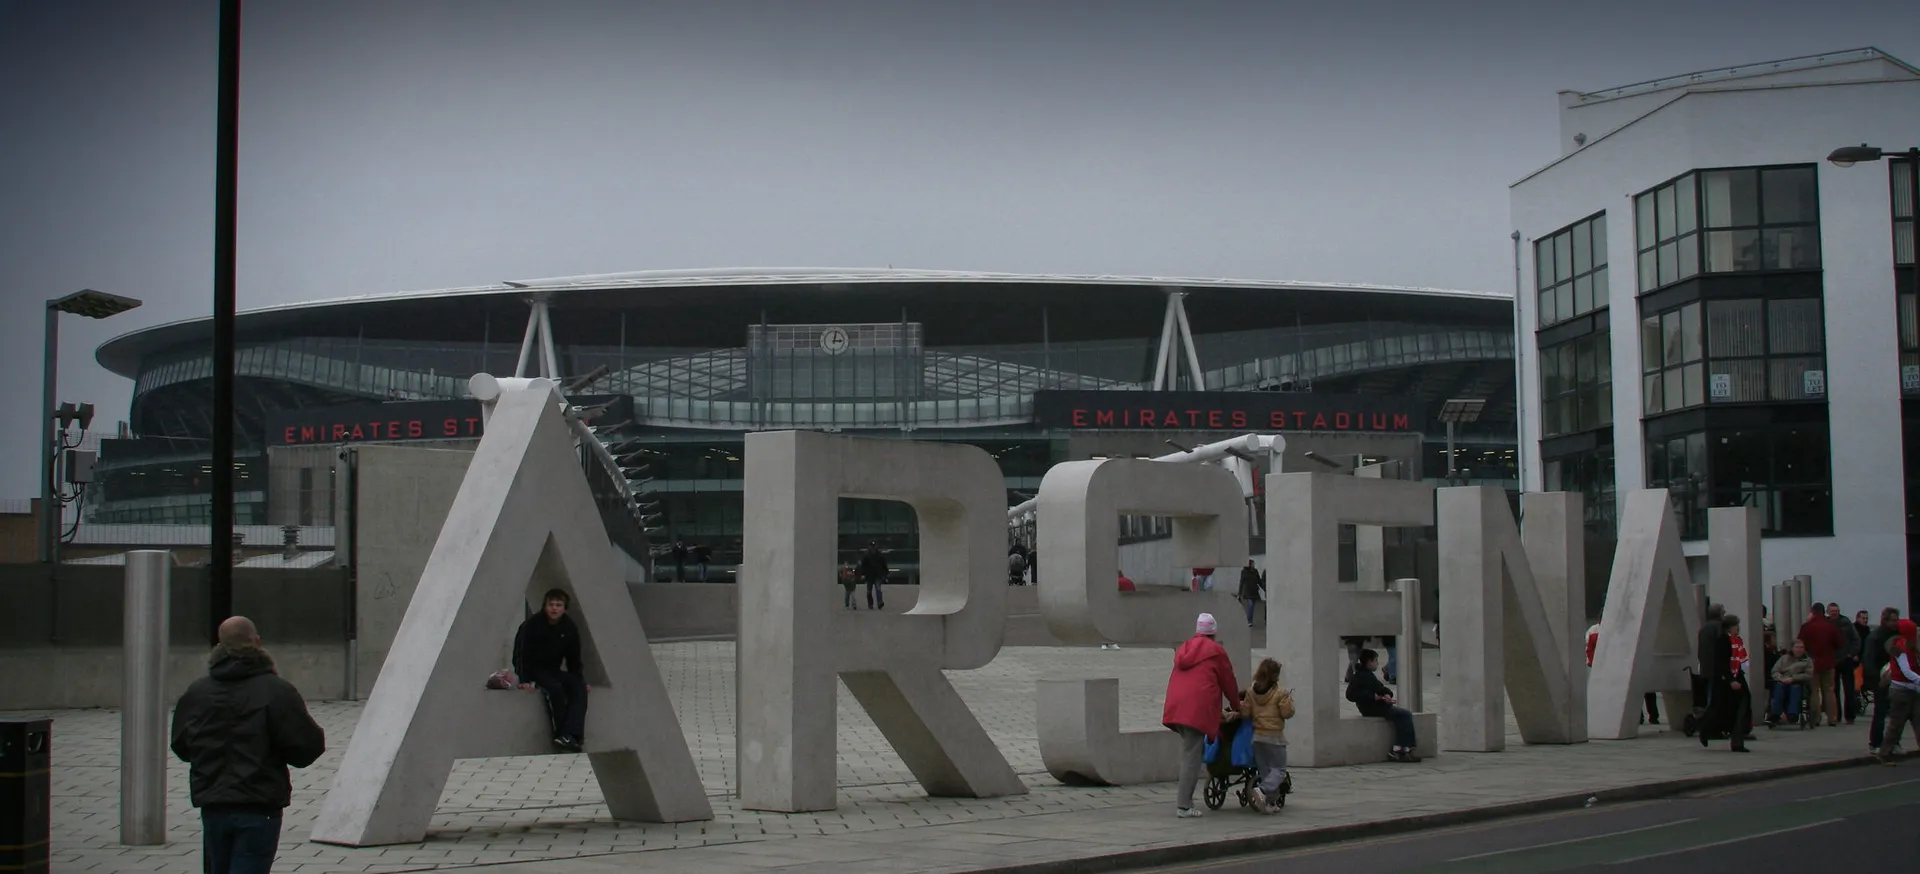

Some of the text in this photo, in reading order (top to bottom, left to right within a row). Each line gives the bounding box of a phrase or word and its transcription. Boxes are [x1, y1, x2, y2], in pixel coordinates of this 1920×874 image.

[1072, 409, 1409, 430] EMIRATES STADIUM
[285, 419, 423, 443] EMIRATES
